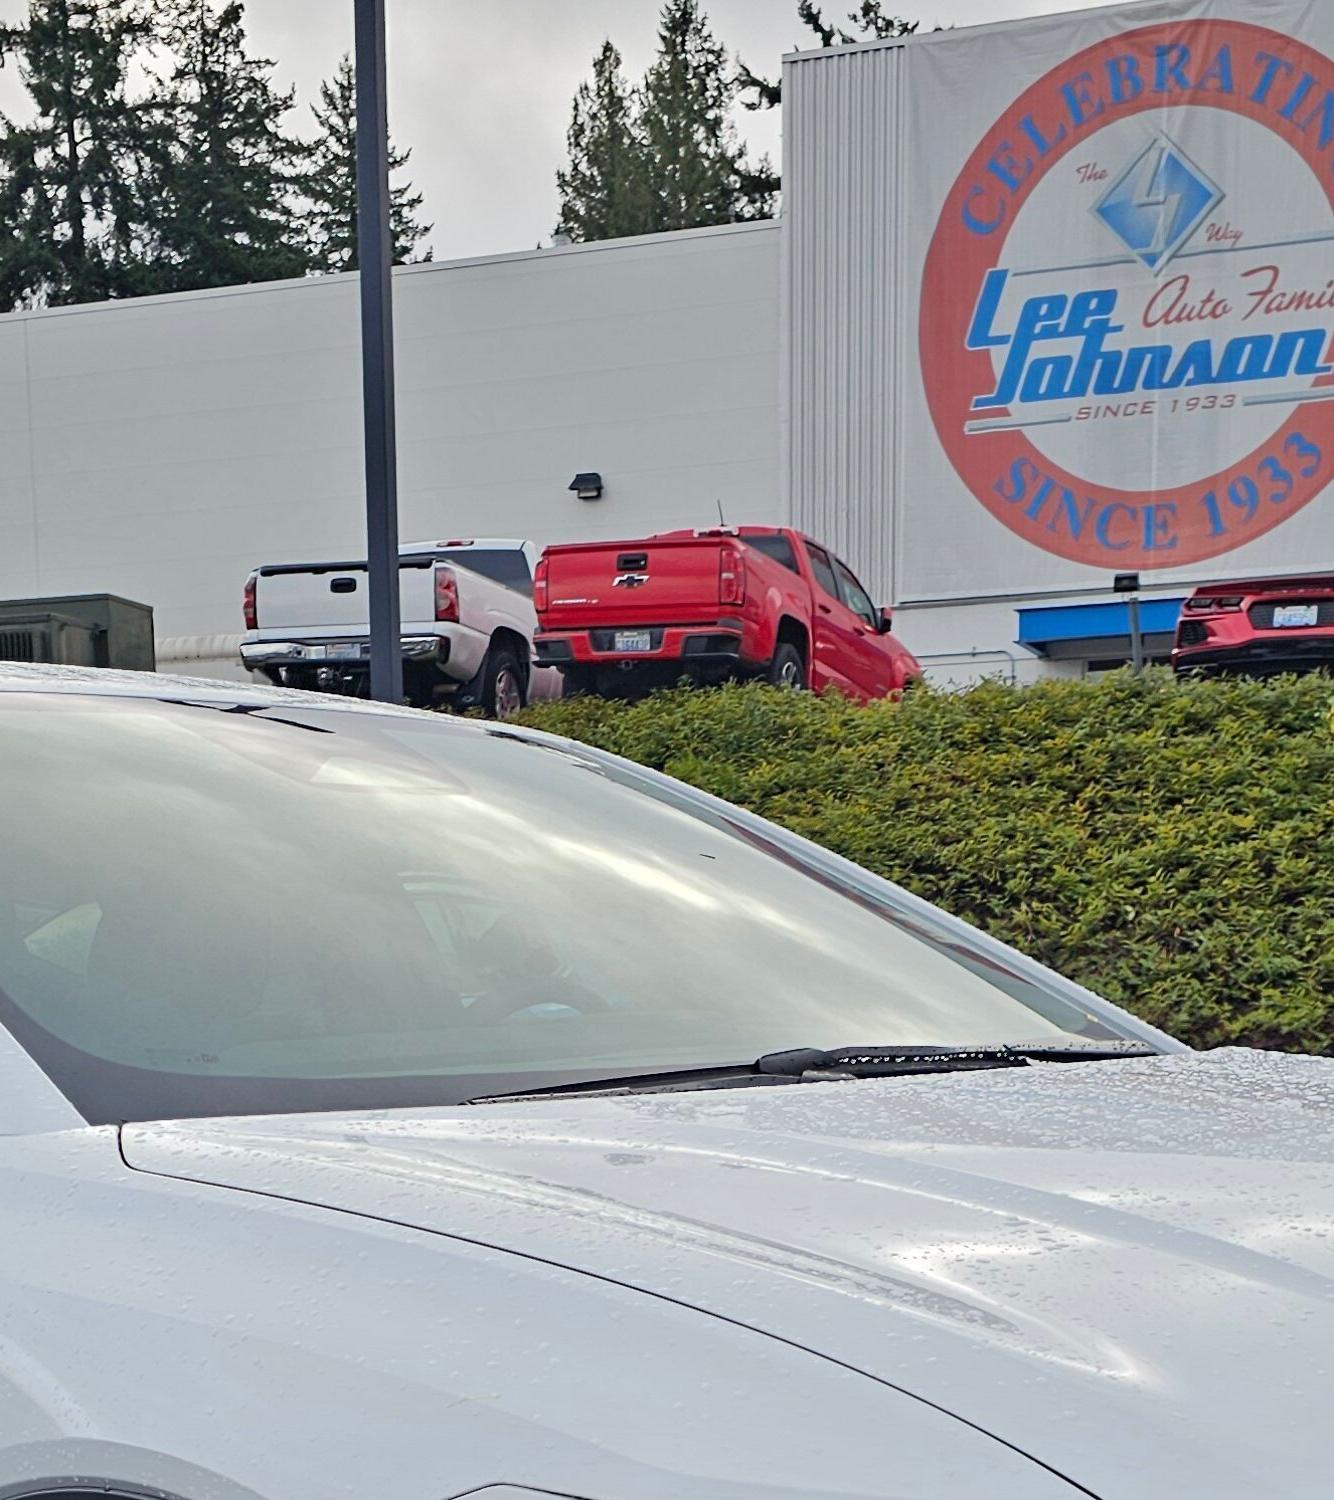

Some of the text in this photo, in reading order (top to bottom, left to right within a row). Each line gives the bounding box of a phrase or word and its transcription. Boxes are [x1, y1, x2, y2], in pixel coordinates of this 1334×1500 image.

[1076, 163, 1109, 184] The
[1206, 223, 1244, 248] Way
[965, 268, 1124, 349] Lee
[1142, 274, 1231, 329] Auto
[970, 324, 1334, 411] Johnson
[1074, 394, 1238, 421] SINCE 1933
[993, 431, 1323, 552] SINCE 1933
